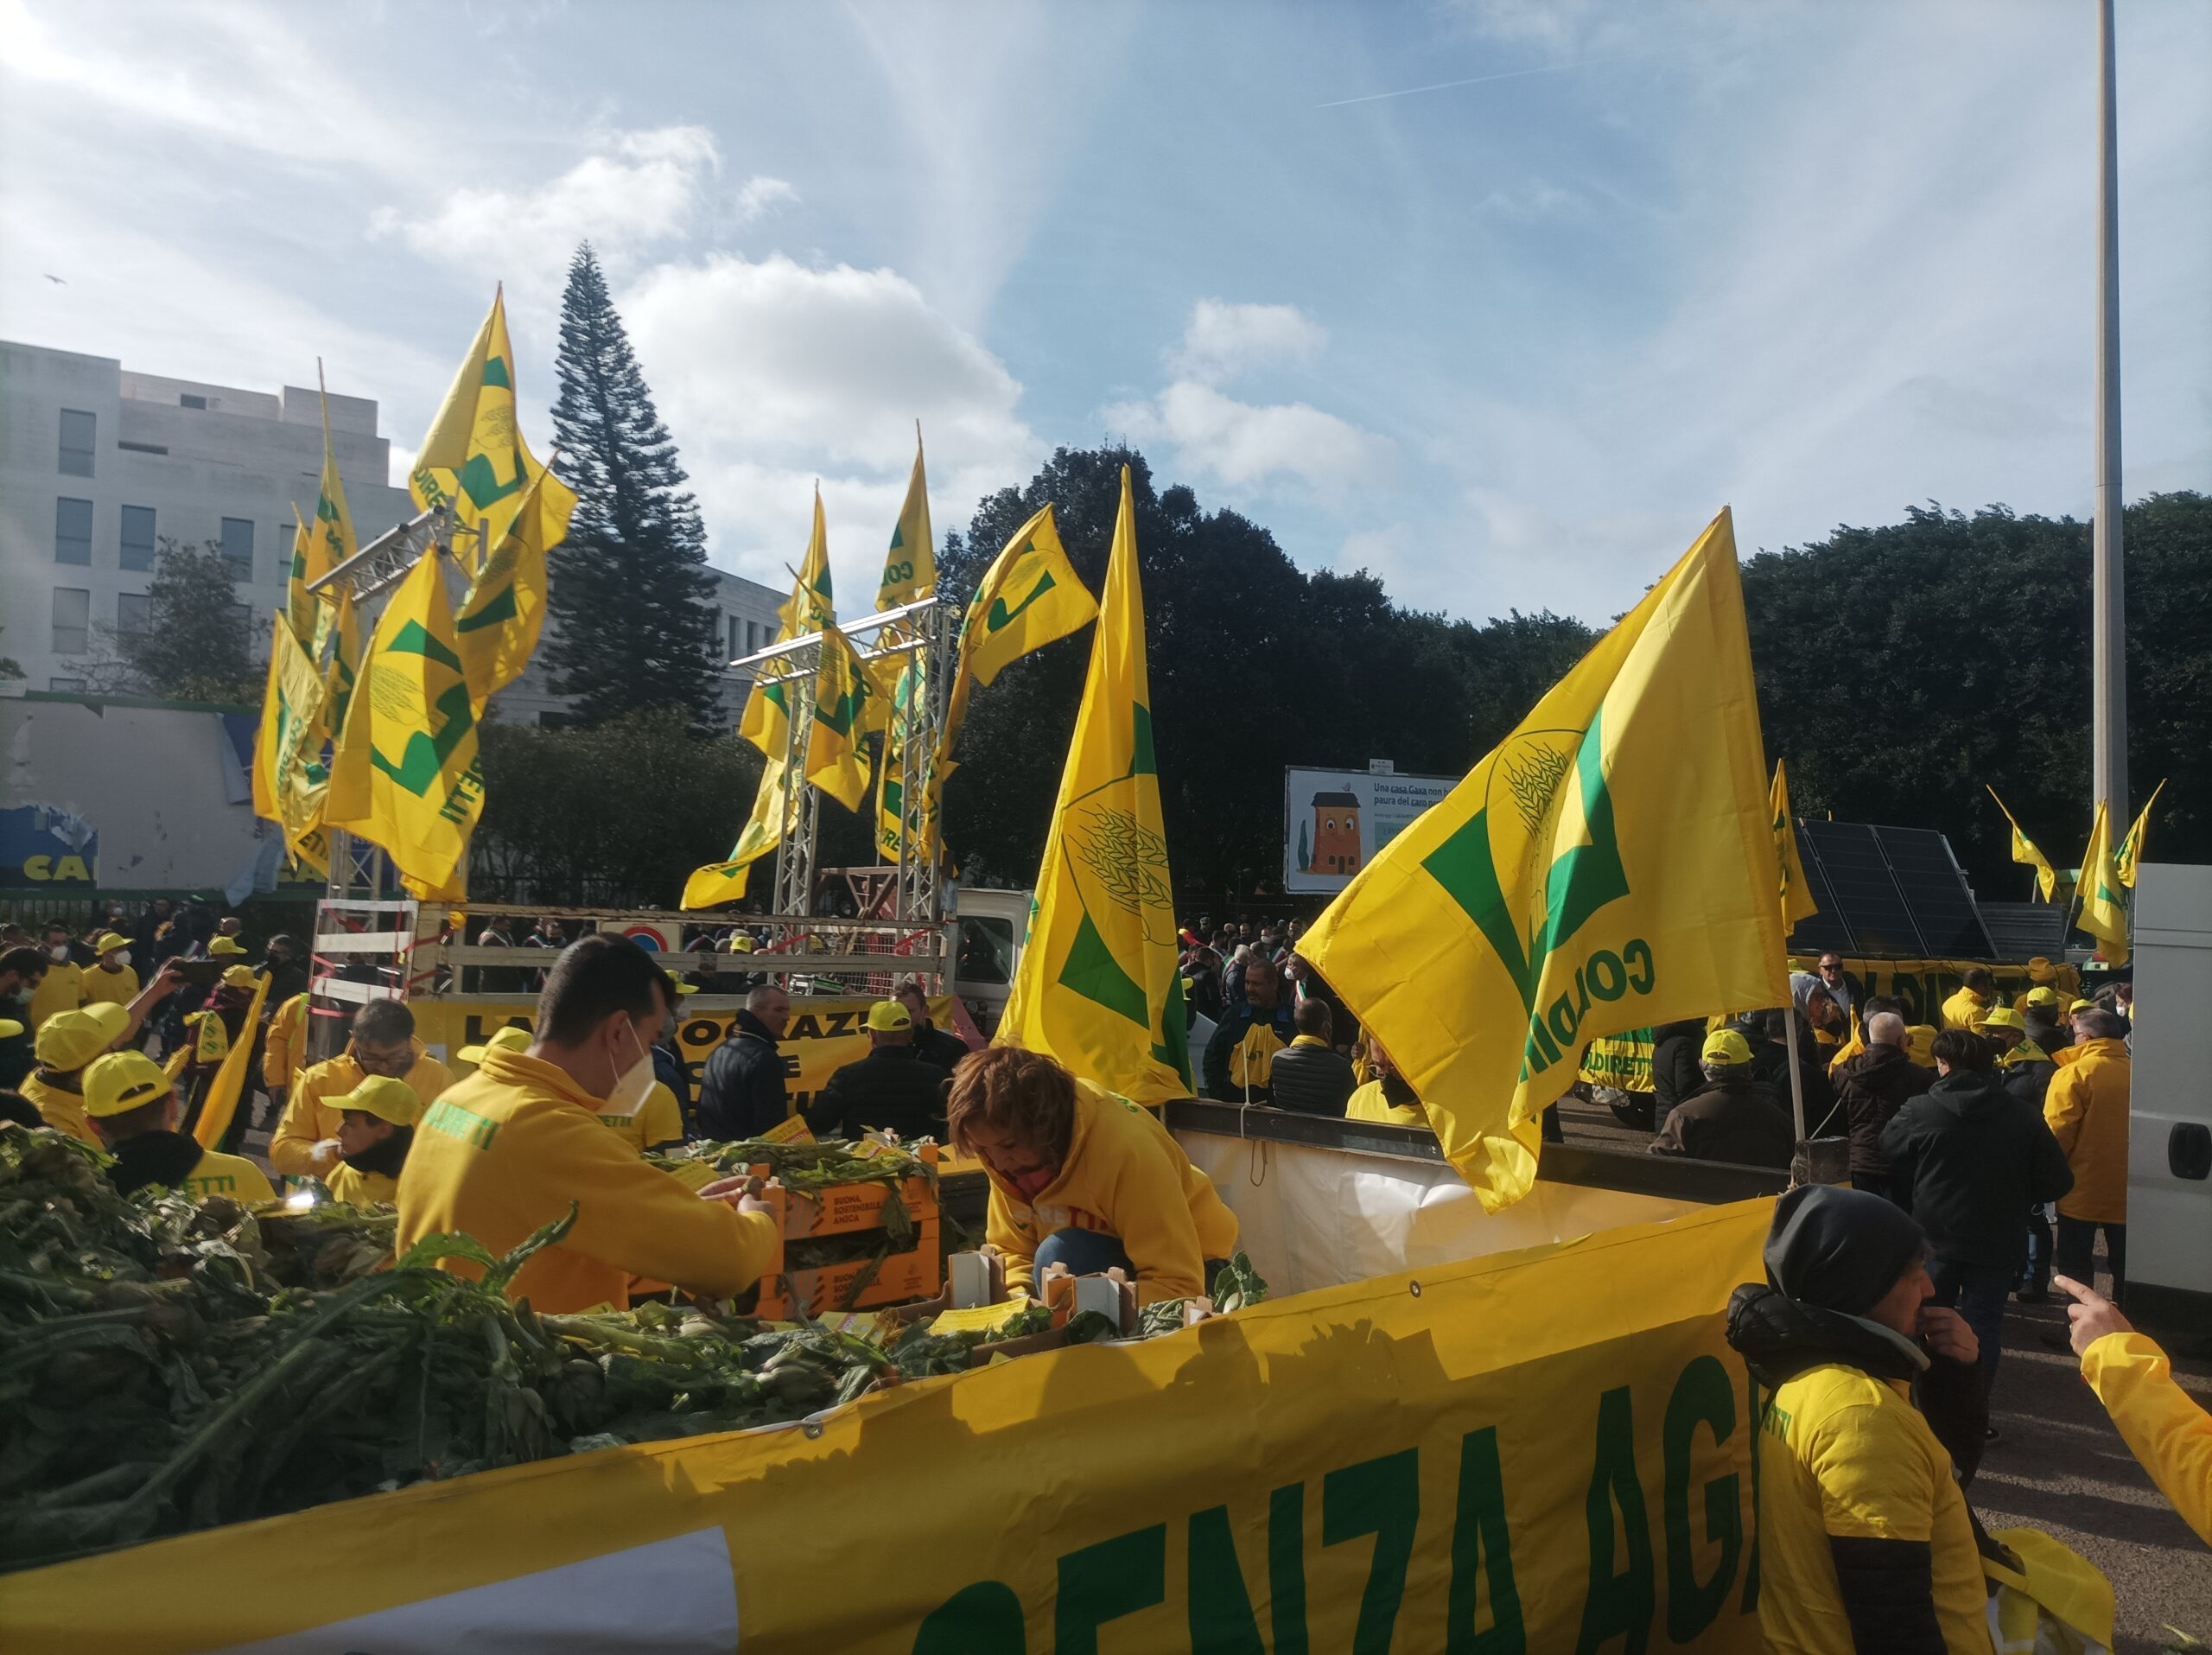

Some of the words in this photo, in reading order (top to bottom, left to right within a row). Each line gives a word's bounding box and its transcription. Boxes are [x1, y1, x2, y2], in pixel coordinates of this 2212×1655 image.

[1374, 782, 1389, 792] Una
[1390, 786, 1408, 794] casa
[1374, 797, 1396, 806] paura
[1397, 797, 1410, 806] del
[23, 854, 99, 881] CA
[912, 1426, 1526, 1655] NZA
